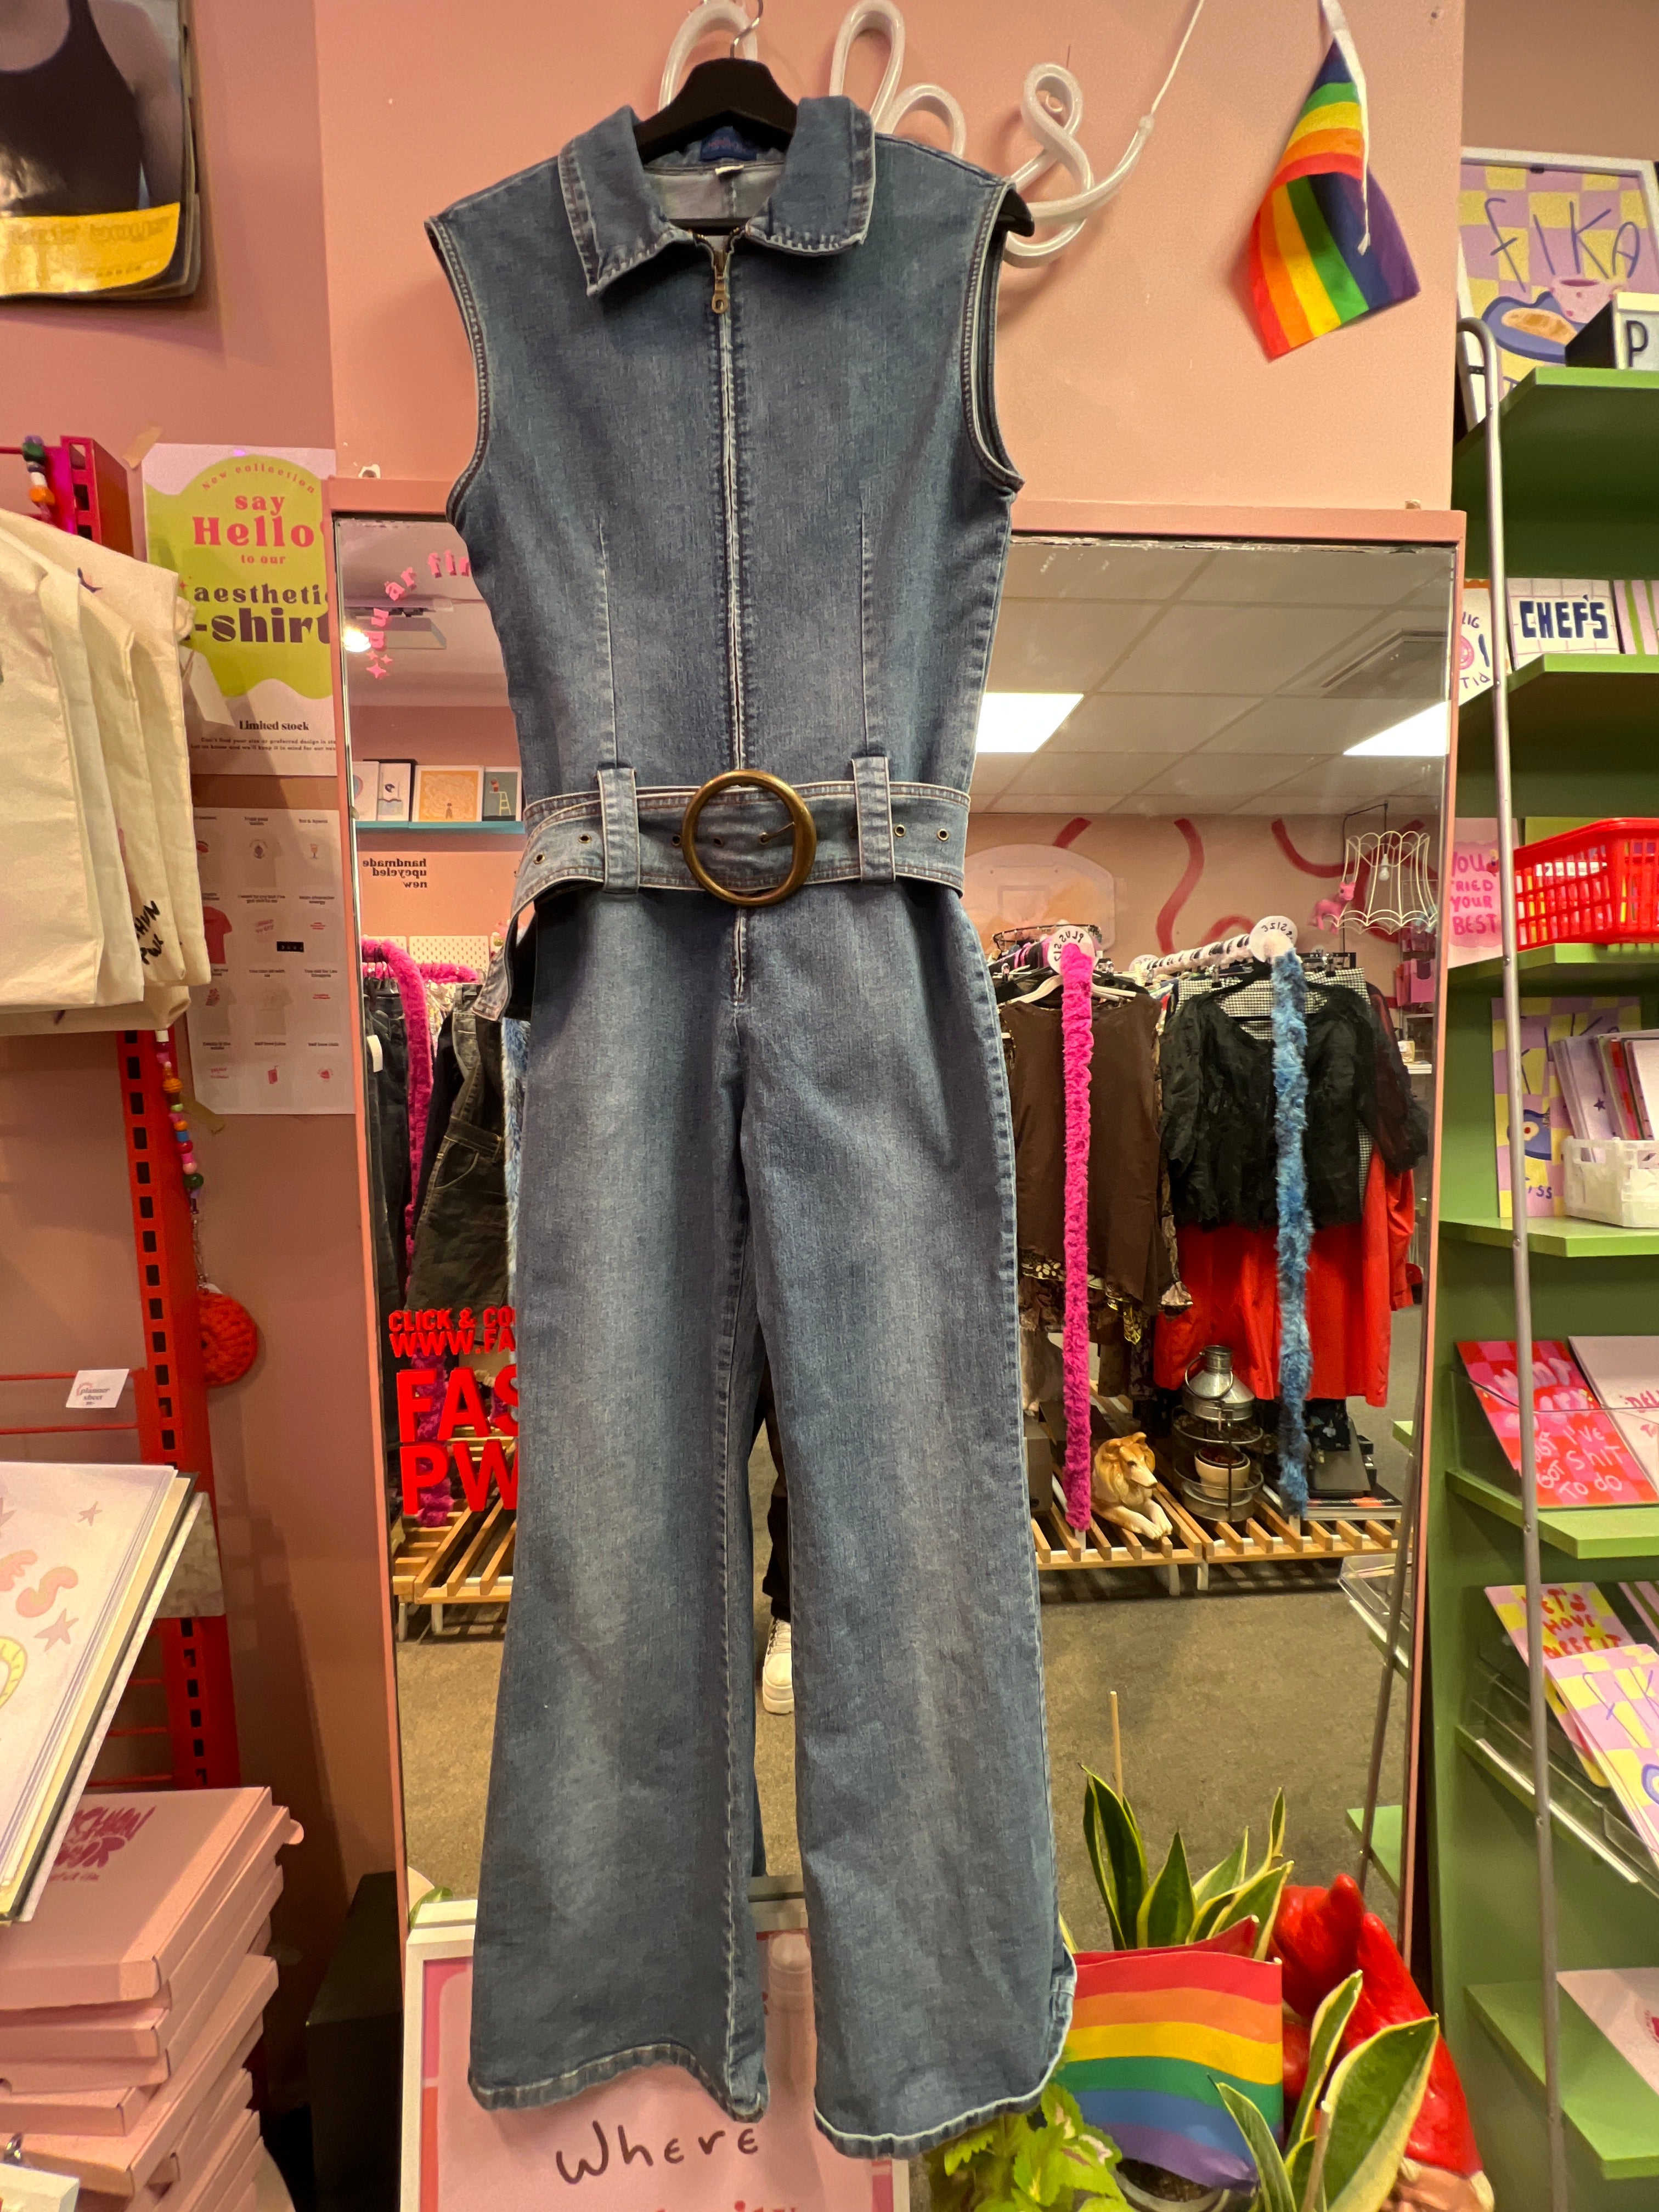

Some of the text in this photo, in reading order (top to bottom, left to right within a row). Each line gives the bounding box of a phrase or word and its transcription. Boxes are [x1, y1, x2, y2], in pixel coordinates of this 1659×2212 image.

[1485, 197, 1640, 292] FIKA
[234, 495, 285, 516] say
[193, 515, 314, 548] Hello
[241, 554, 286, 564] to our
[1519, 594, 1609, 639] CHEF'S
[239, 720, 309, 731] Limited stock
[1452, 879, 1493, 892] RIED
[1451, 895, 1492, 912] YOUR
[1453, 914, 1497, 935] BEST
[388, 1305, 516, 1331] CLICK & CO
[556, 2119, 758, 2185] Where
